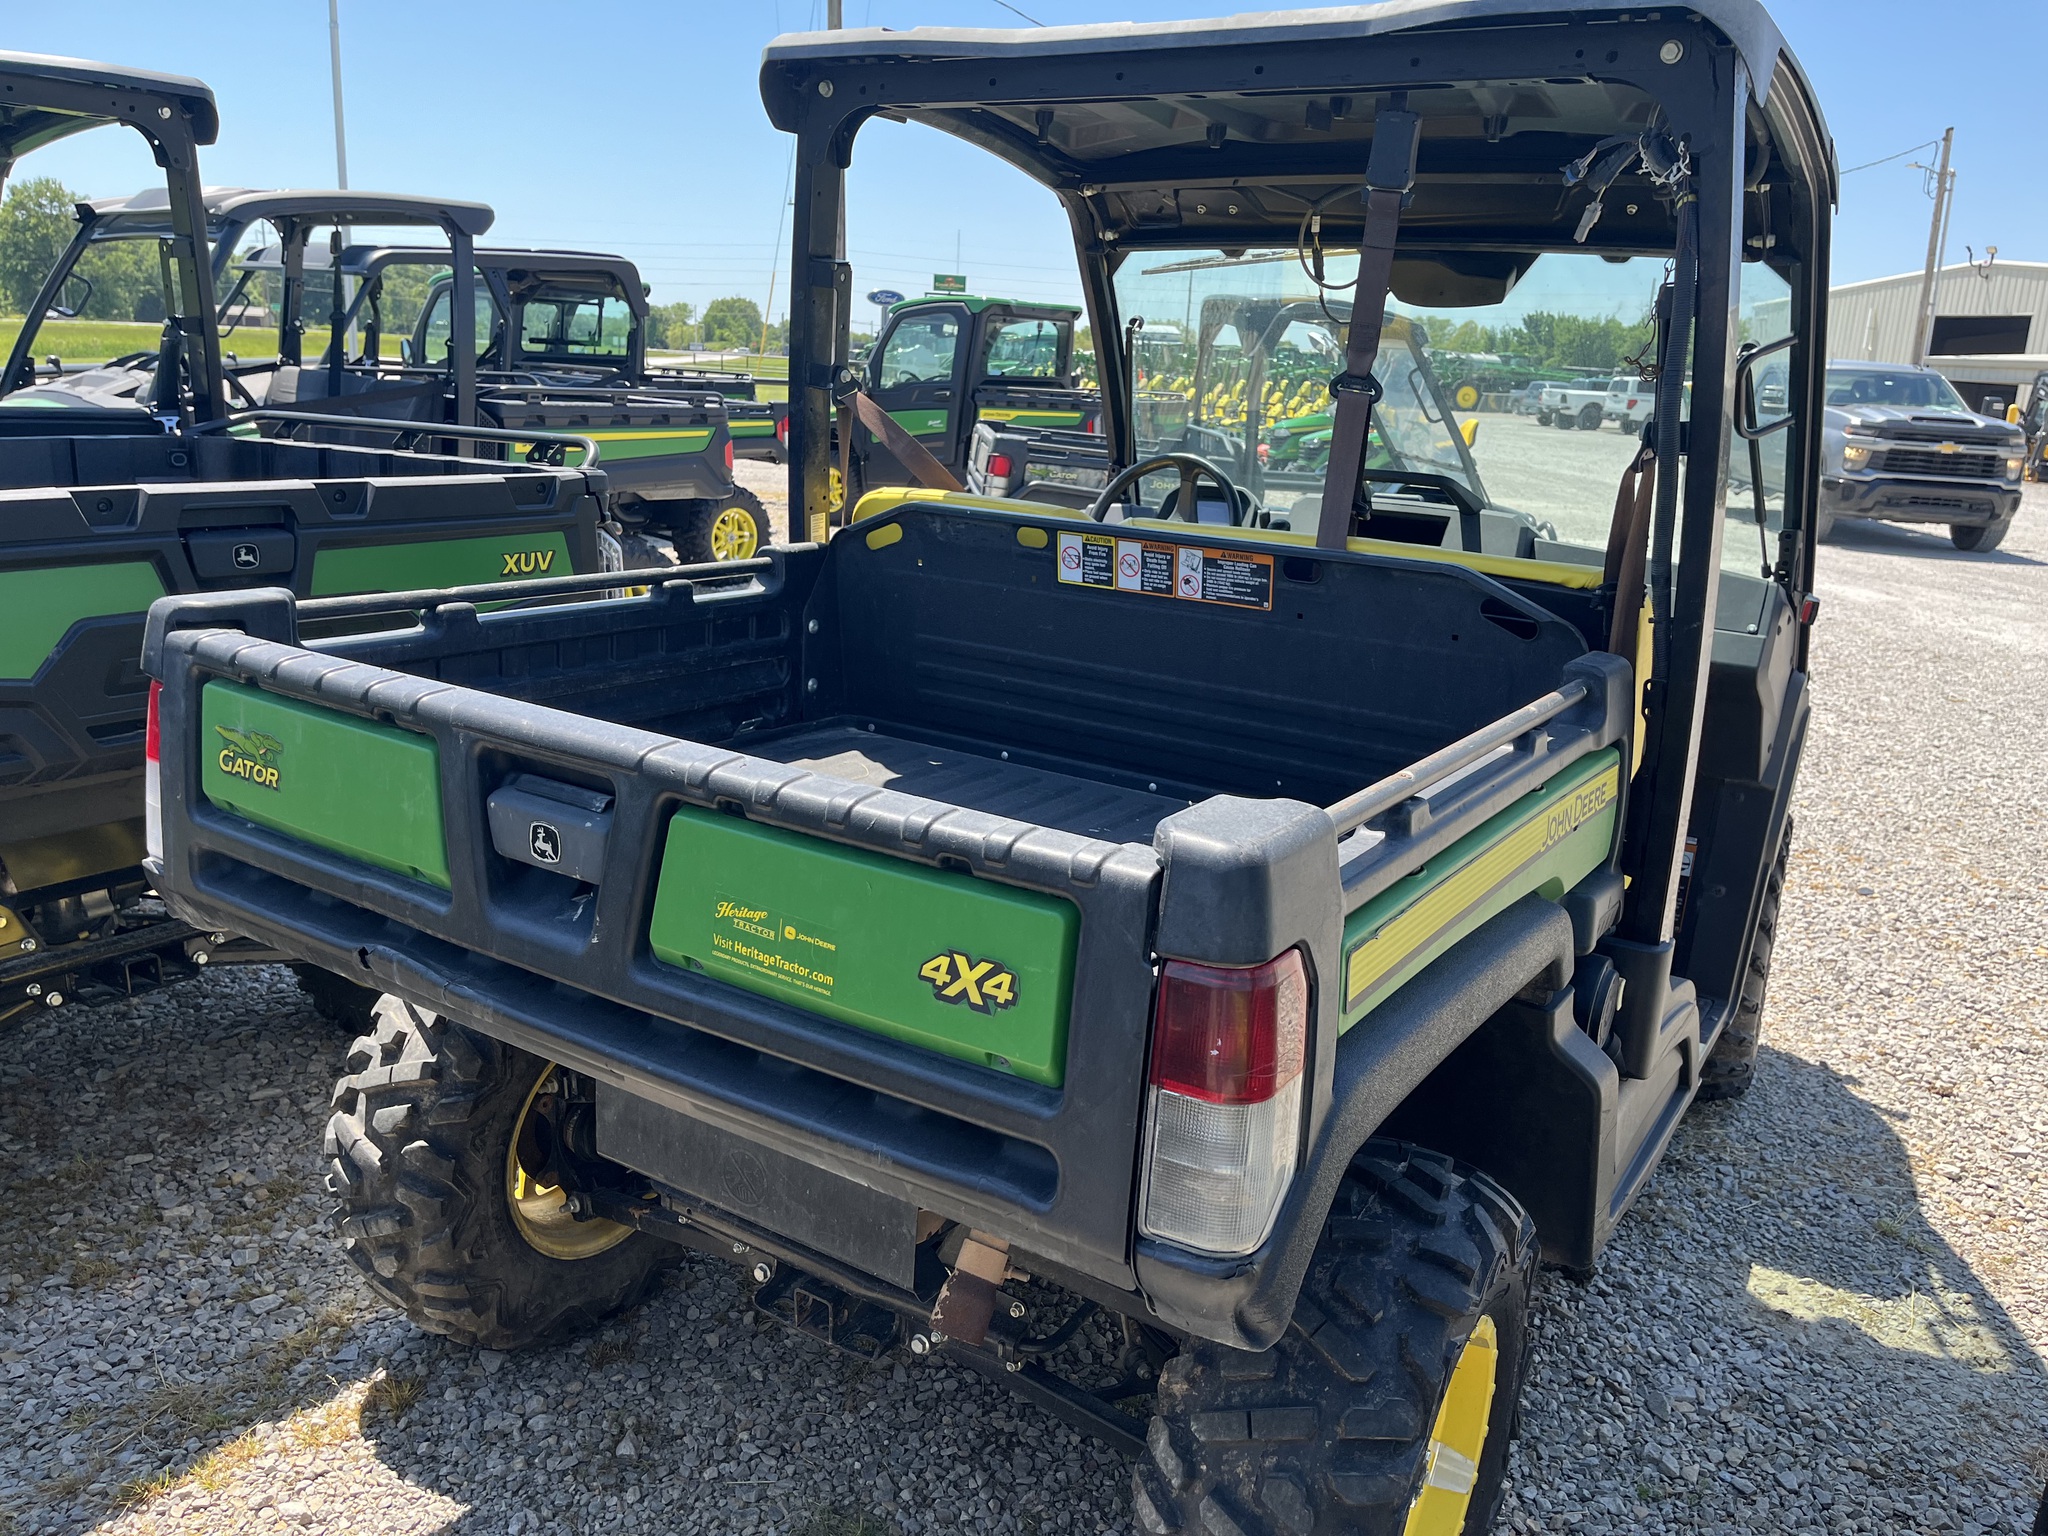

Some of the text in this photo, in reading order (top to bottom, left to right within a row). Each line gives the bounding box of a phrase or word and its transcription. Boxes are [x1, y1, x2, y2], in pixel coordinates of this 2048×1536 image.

[874, 292, 899, 304] Ford
[1049, 471, 1078, 480] GATOR
[1089, 535, 1112, 545] CAUTION
[1149, 543, 1175, 552] WARNING
[501, 550, 555, 575] XUV
[1226, 552, 1254, 562] WARNING
[219, 748, 279, 788] GATOR
[1541, 781, 1608, 848] JOHN DEERE
[715, 901, 768, 922] Heritage
[733, 918, 775, 940] TRACTOR
[796, 932, 836, 951] JOHN DEERE
[713, 932, 834, 986] Visit HeritageTractor.com
[919, 950, 1015, 1008] 4X4
